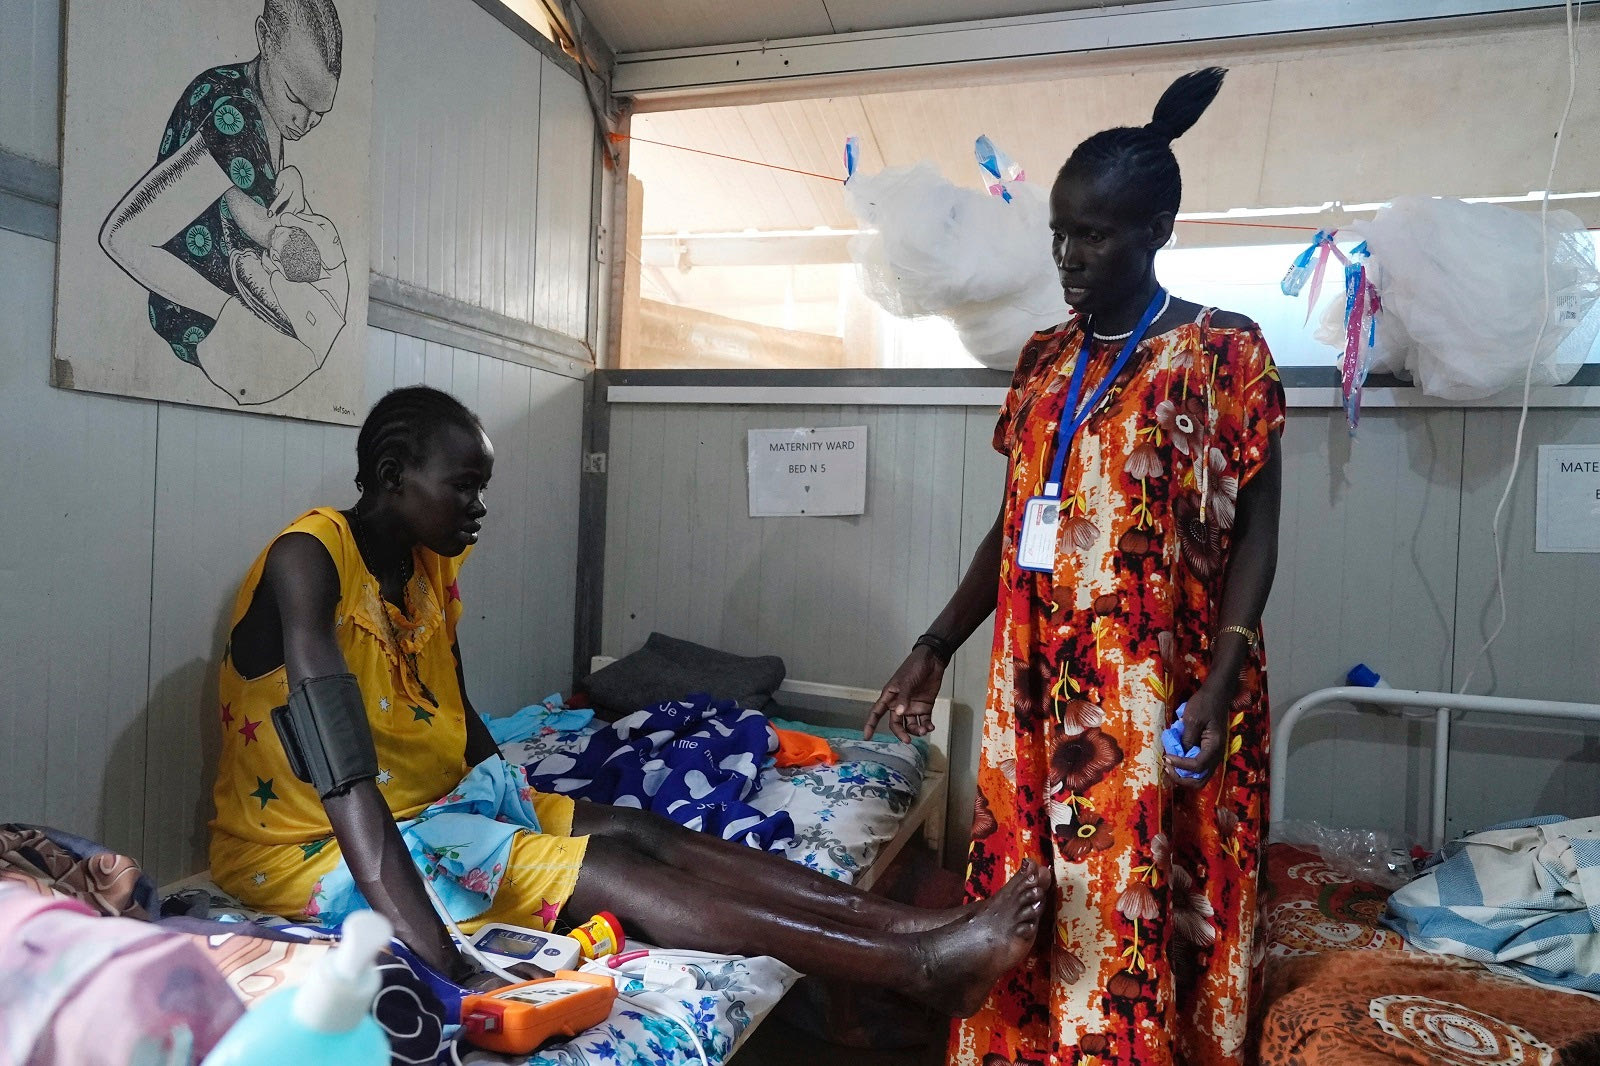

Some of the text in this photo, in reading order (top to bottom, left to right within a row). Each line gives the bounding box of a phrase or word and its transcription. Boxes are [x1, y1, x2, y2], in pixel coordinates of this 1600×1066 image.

[769, 441, 855, 452] MATERNITY WARD
[788, 464, 826, 473] BED N 5
[1561, 461, 1600, 473] MATE
